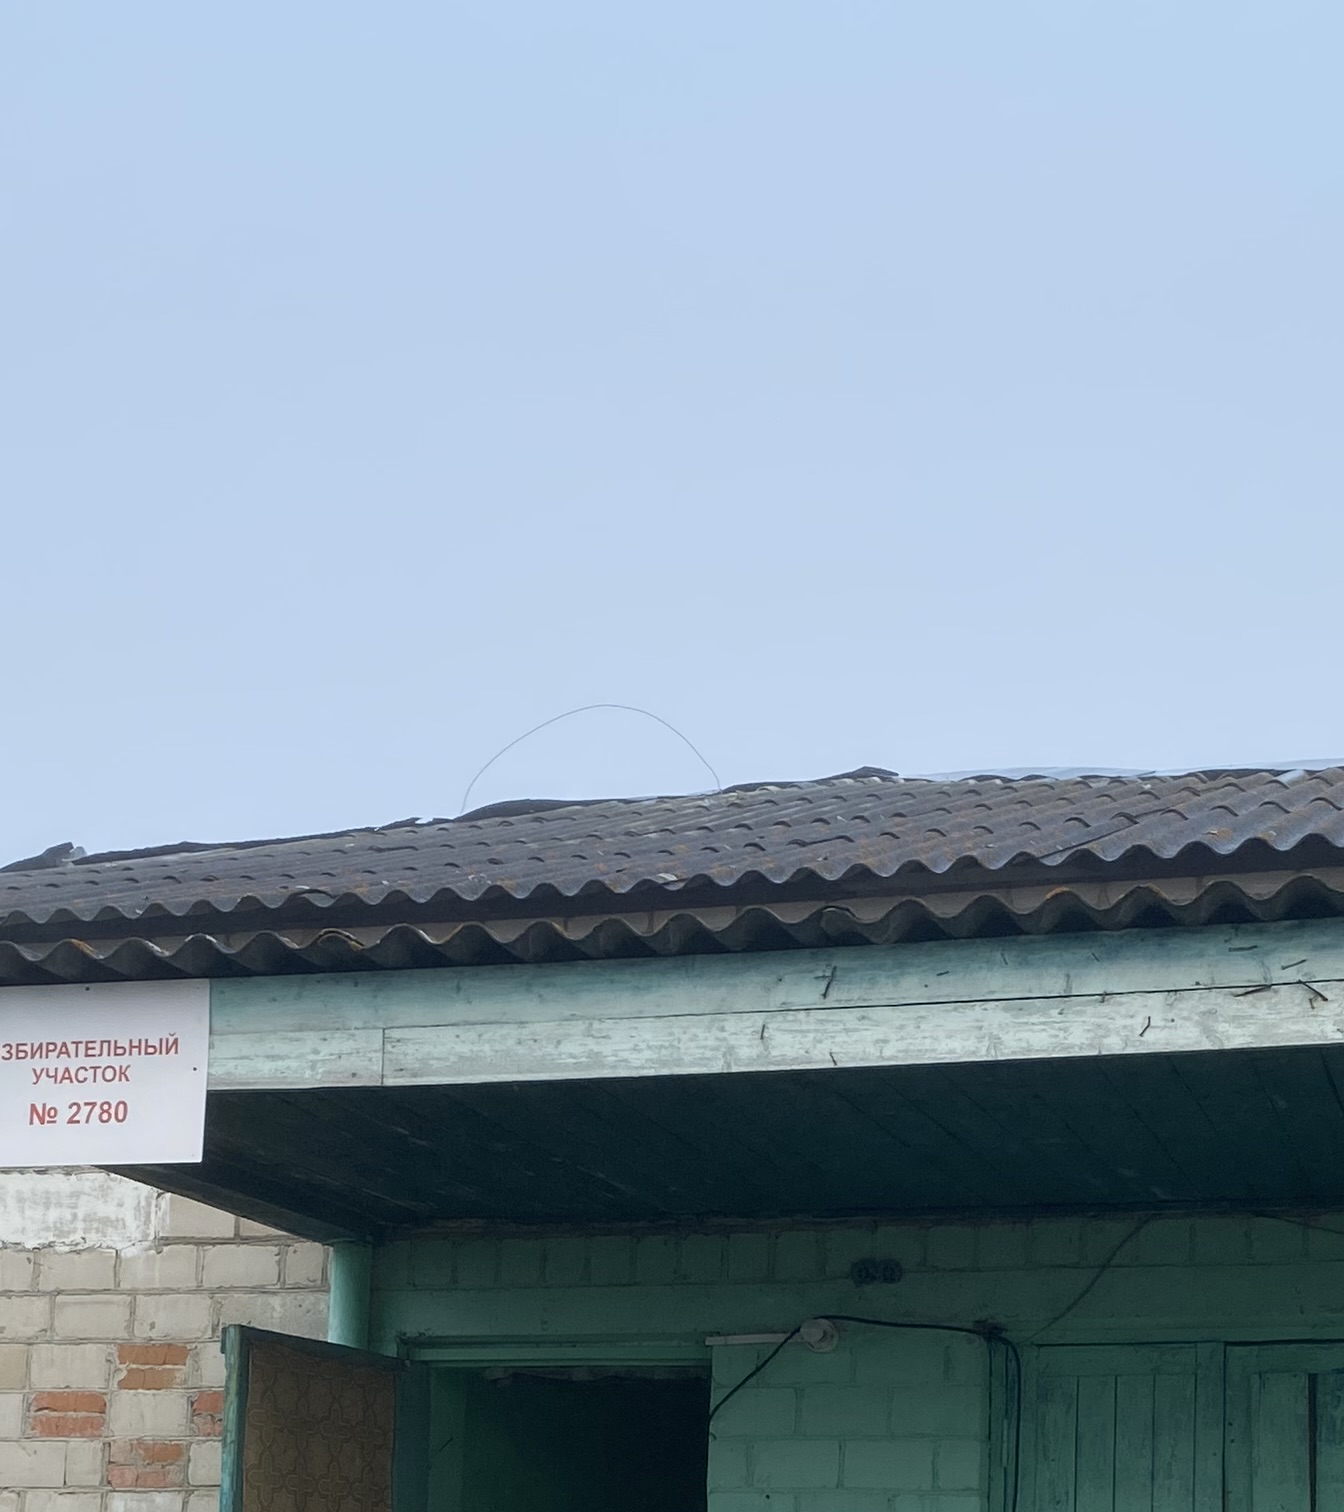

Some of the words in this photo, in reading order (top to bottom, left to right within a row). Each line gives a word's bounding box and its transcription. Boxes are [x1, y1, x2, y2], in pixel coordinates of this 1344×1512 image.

[32, 1065, 131, 1085] УЧАСТОК
[28, 1102, 59, 1126] №
[66, 1100, 129, 1125] 2780
